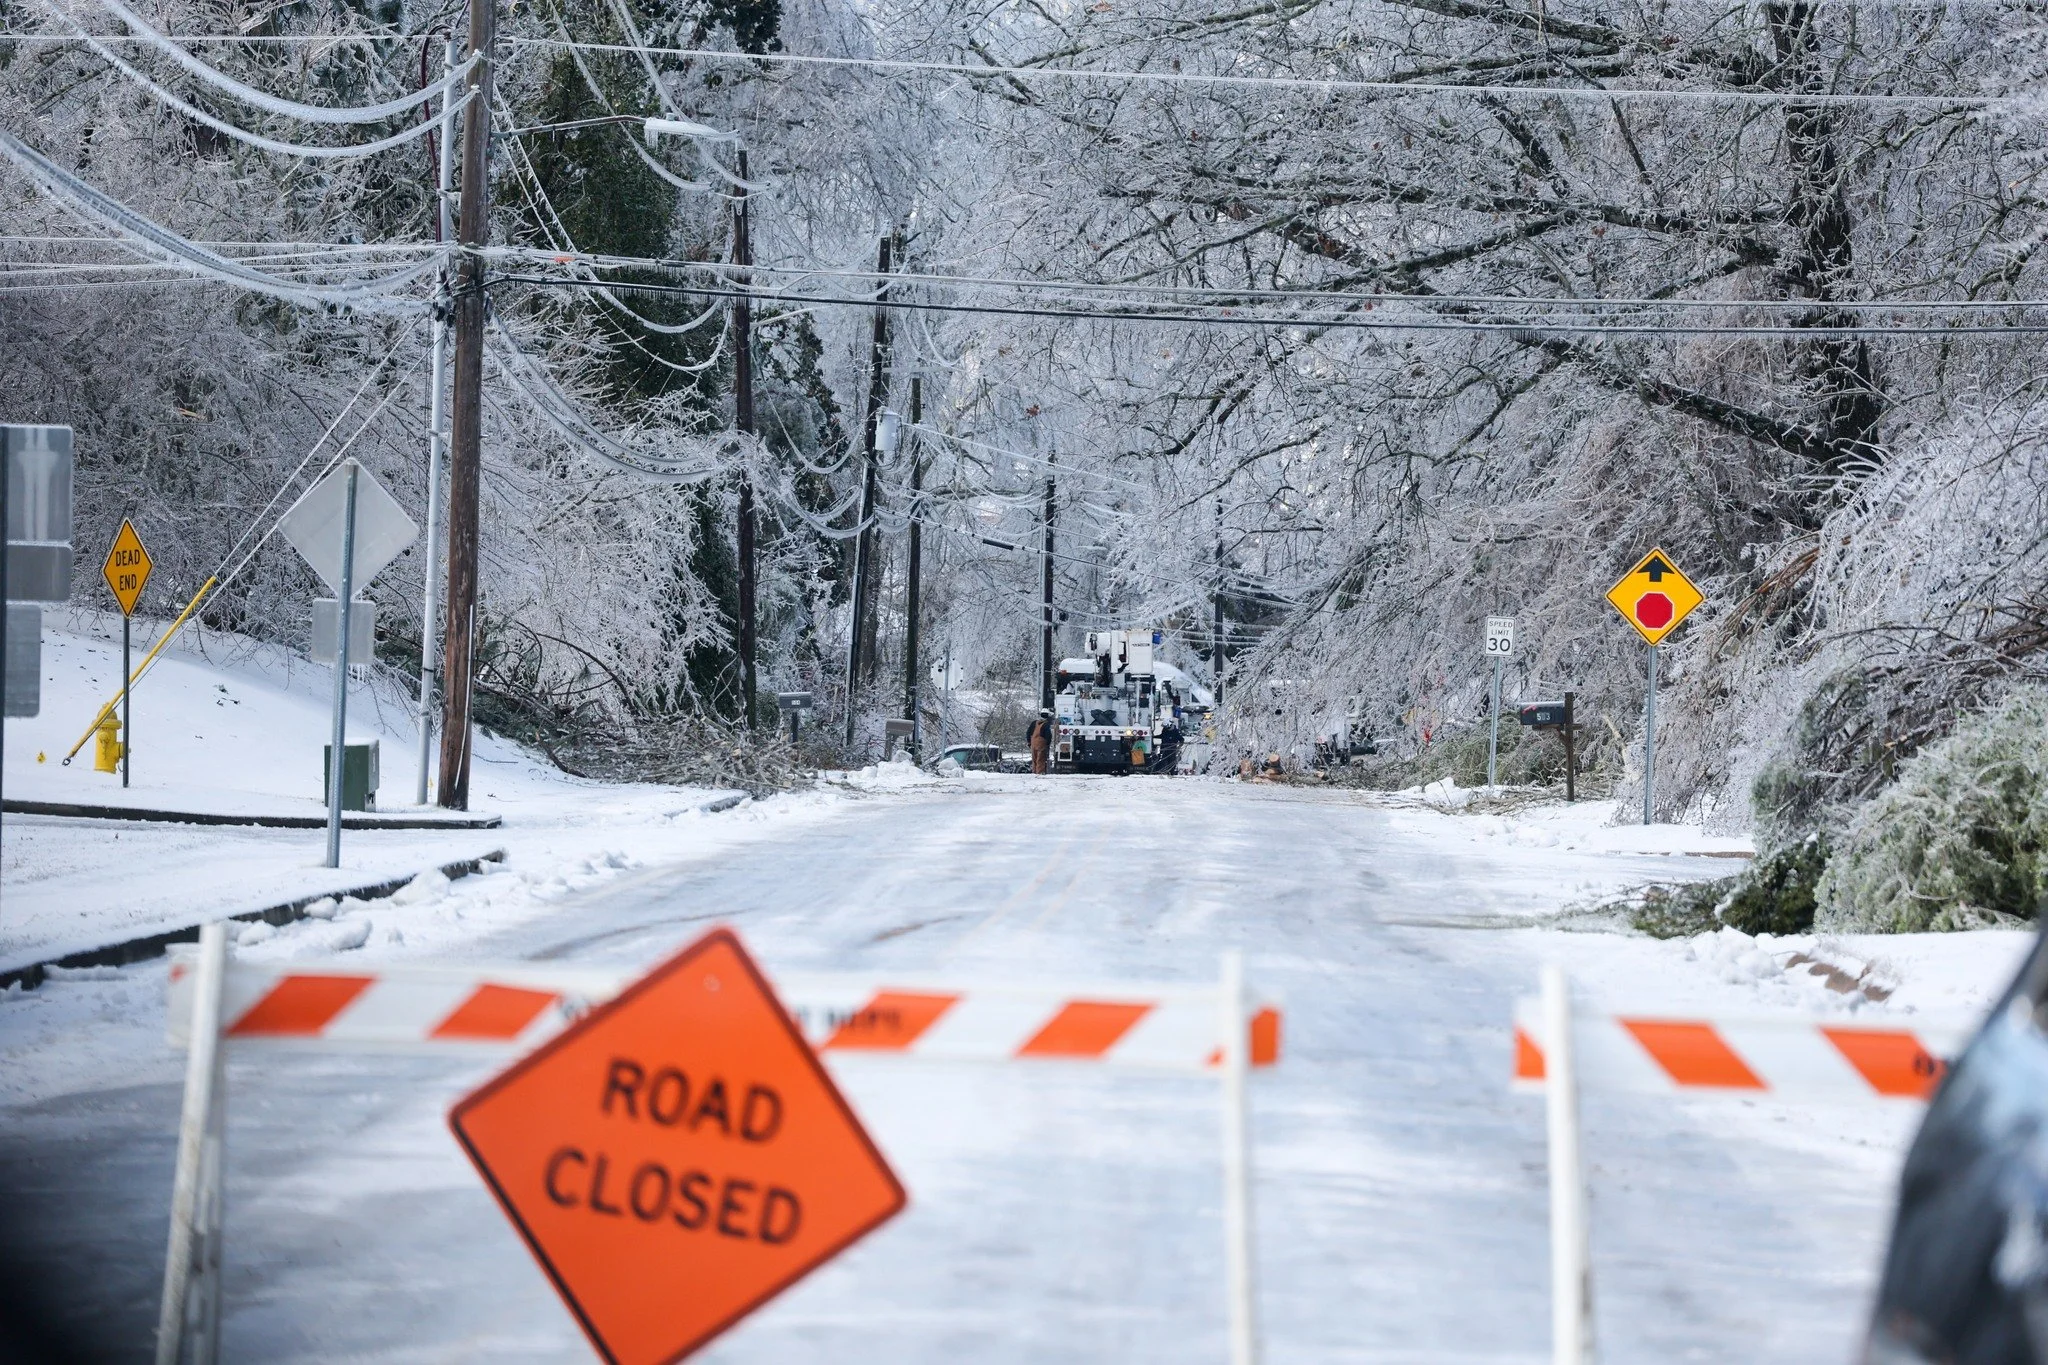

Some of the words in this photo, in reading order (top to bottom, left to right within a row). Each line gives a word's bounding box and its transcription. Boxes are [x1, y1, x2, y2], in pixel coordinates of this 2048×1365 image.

[115, 549, 140, 566] DEAD
[119, 574, 137, 591] END
[1488, 638, 1511, 652] 30
[602, 1056, 784, 1144] ROAD
[544, 1146, 803, 1245] CLOSED
